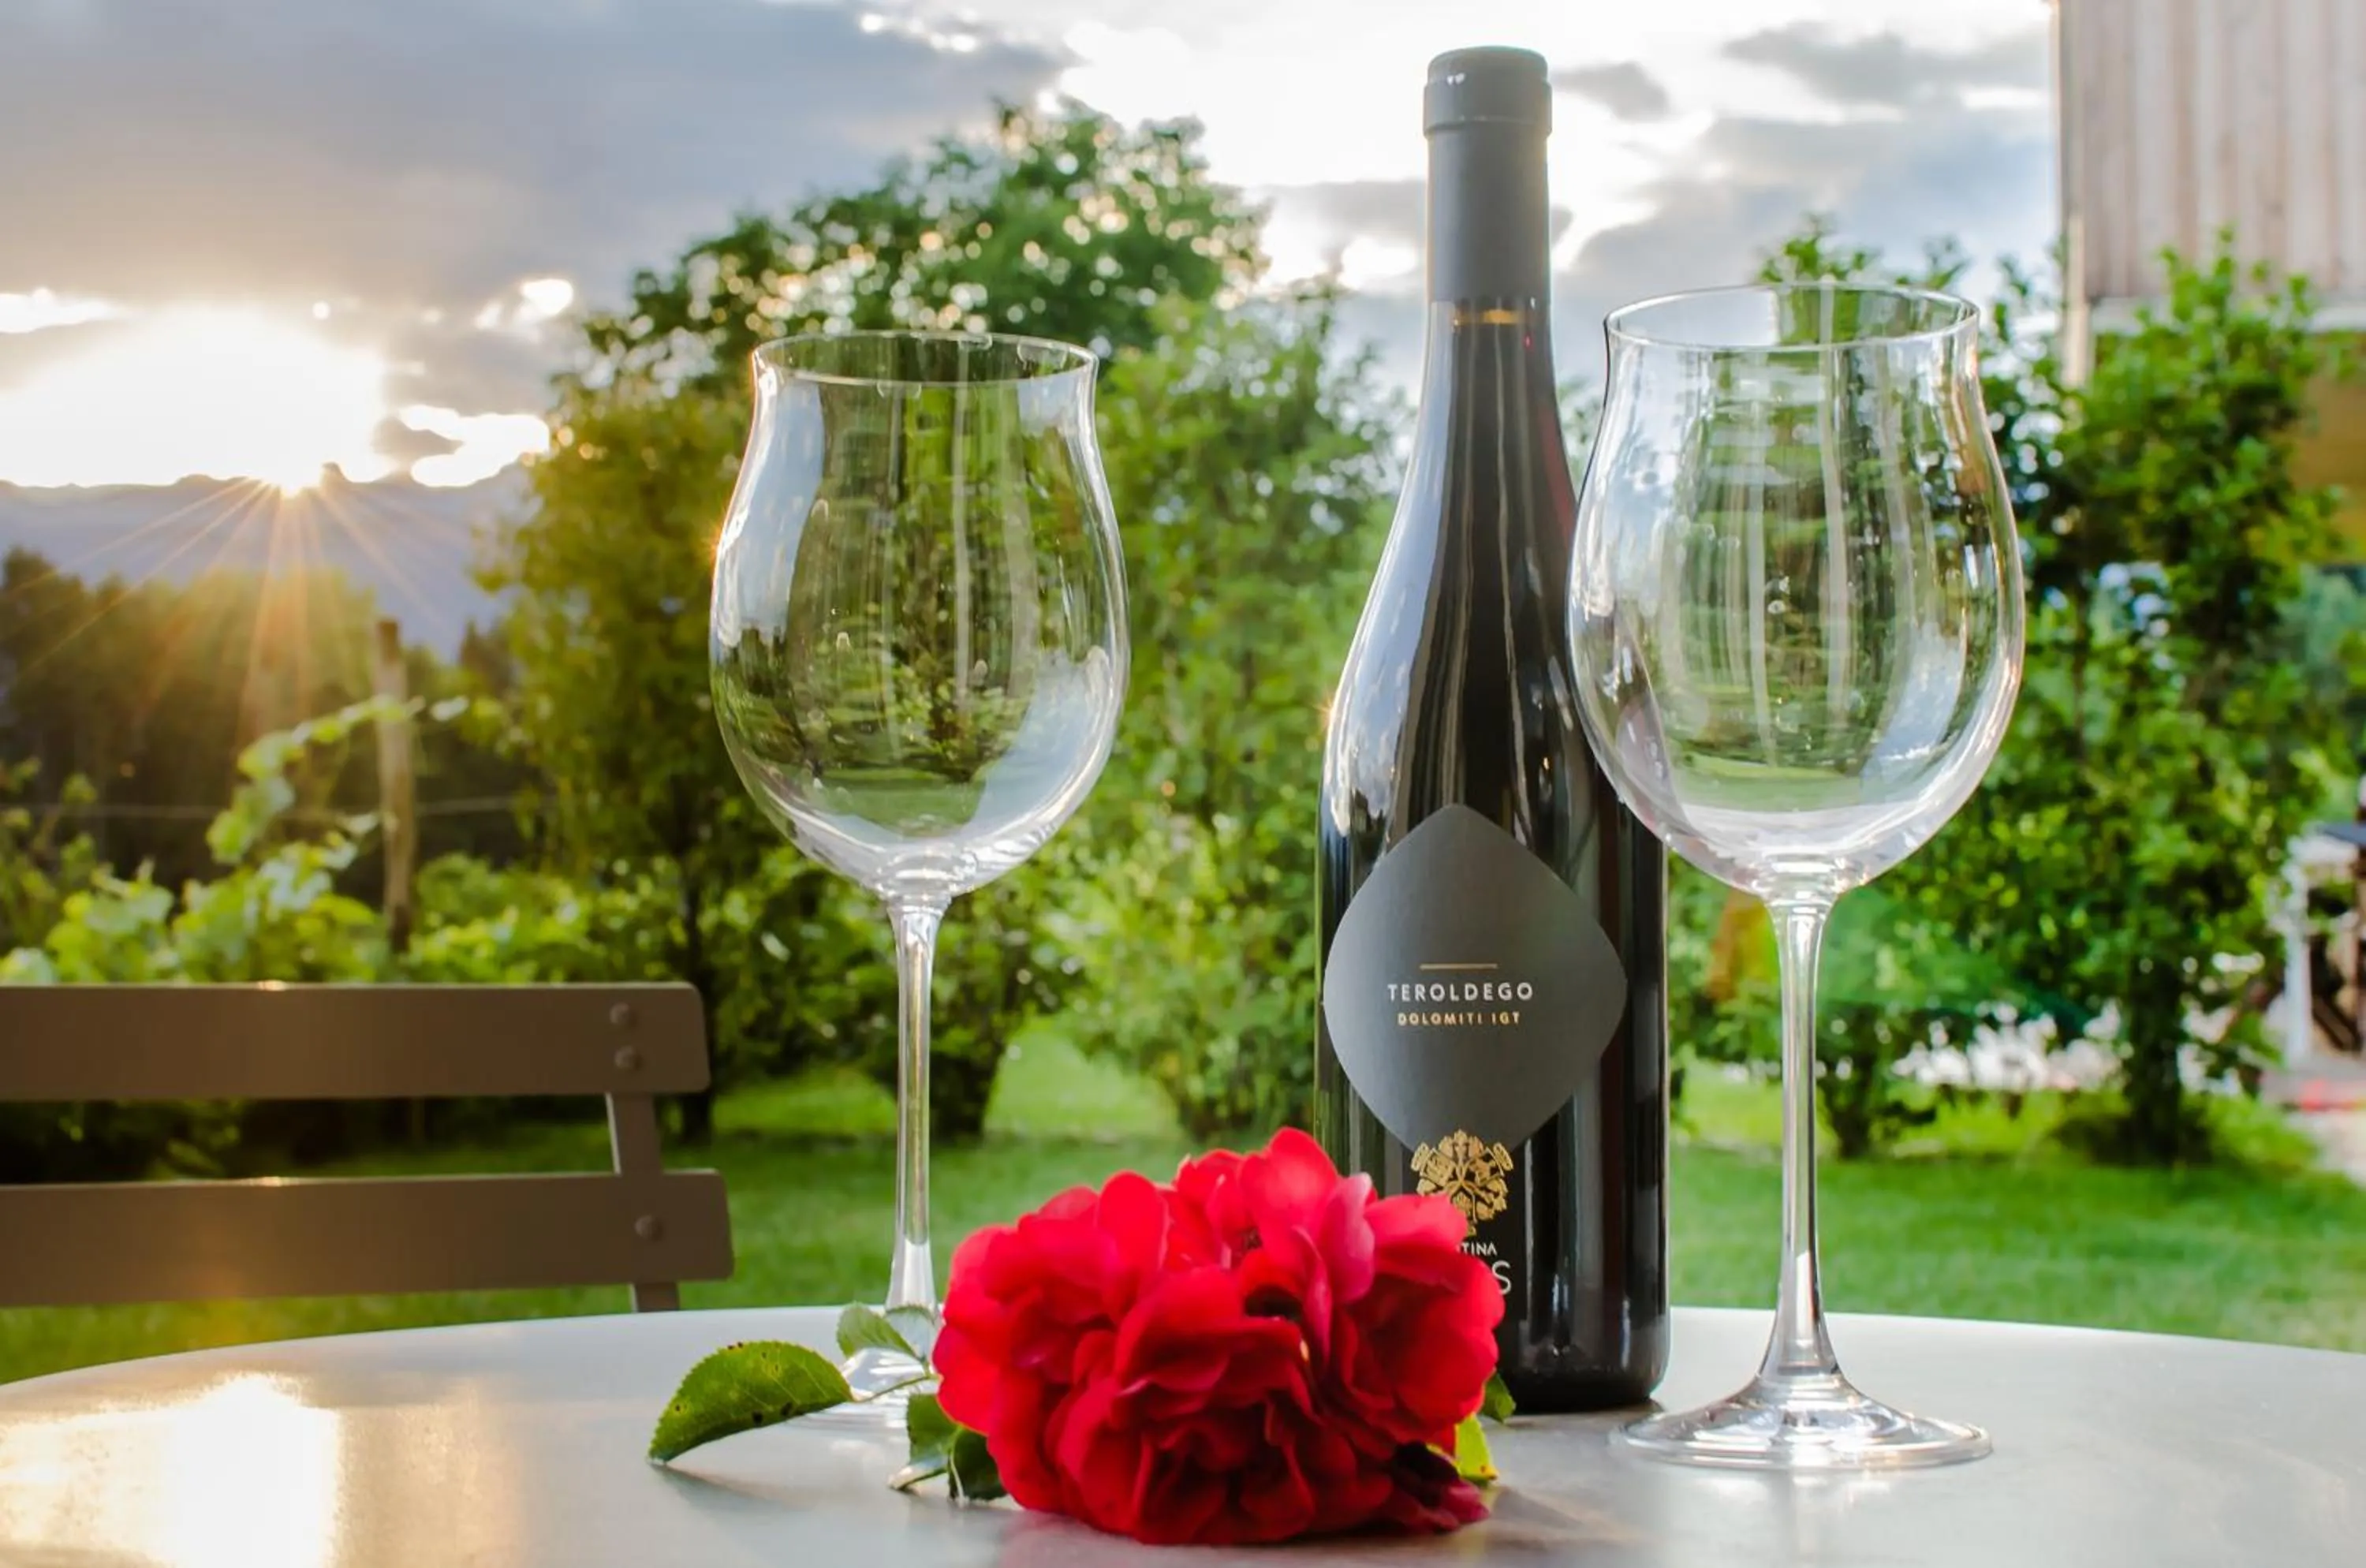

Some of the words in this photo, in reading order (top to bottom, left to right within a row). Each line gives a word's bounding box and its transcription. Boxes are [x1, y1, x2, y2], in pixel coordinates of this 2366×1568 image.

[1387, 983, 1533, 1002] TEROLDEGO
[1398, 1012, 1482, 1025] DOLOMITI
[1492, 1012, 1521, 1025] IGT
[1456, 1241, 1498, 1256] TINA
